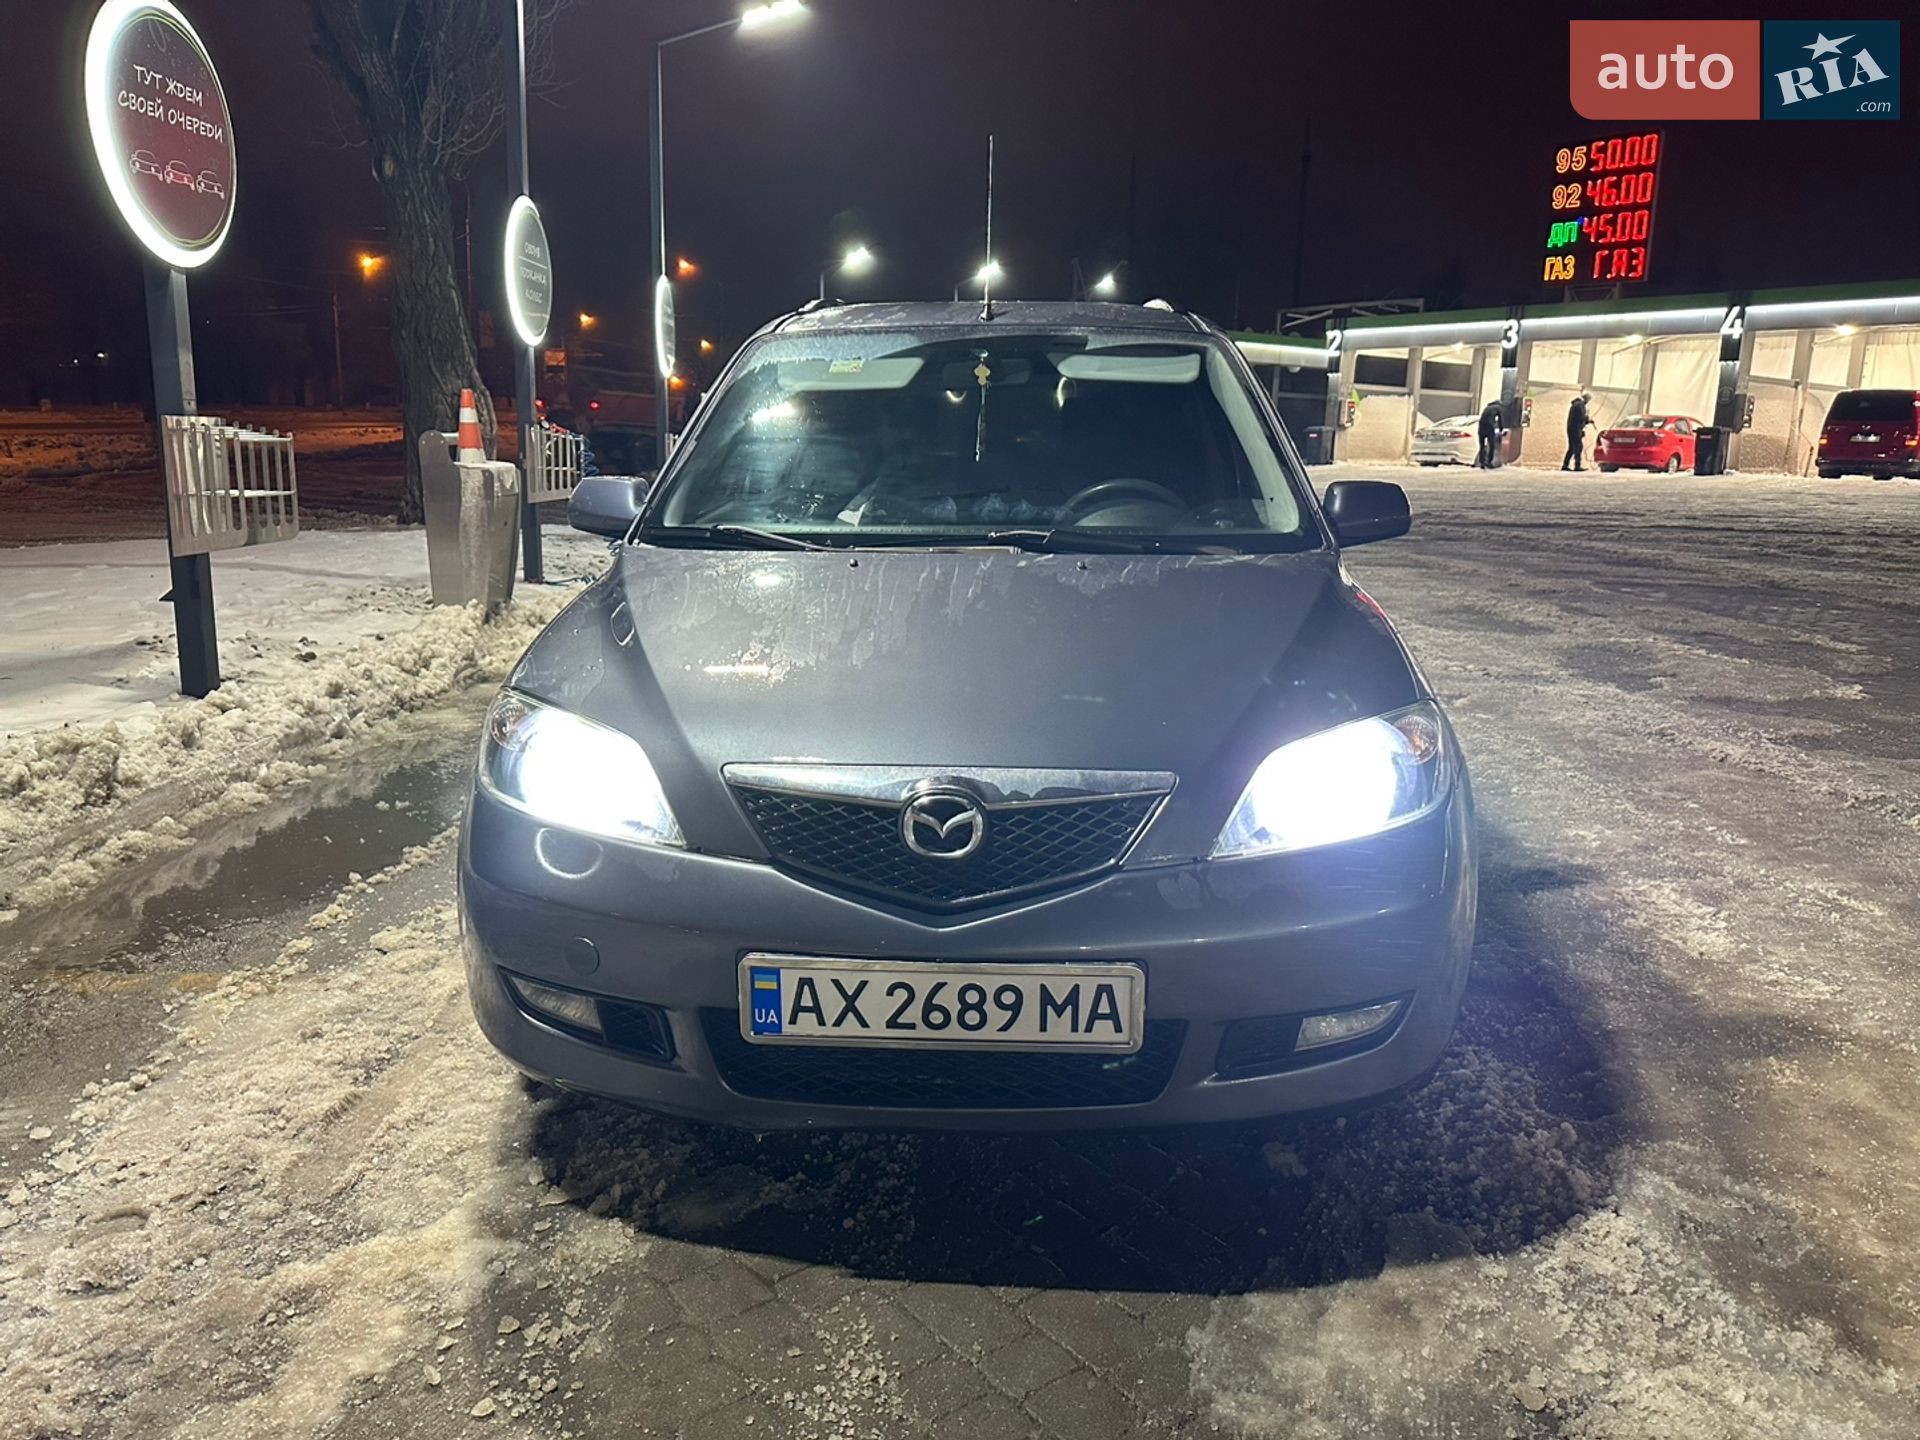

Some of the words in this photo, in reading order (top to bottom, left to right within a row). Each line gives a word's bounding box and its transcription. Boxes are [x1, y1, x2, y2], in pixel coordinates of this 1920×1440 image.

[133, 64, 163, 90] ТУТ
[165, 77, 203, 107] ЖДЕМ
[118, 90, 164, 122] СВОЕЙ
[167, 109, 223, 144] ОЧЕРЕДИ
[1556, 146, 1587, 173] 95
[1590, 133, 1659, 172] 50.00
[1552, 183, 1582, 209] 92
[1586, 172, 1654, 206] 46.00
[1582, 209, 1649, 243] 45.00
[1543, 254, 1576, 281] ГАЗ
[1501, 318, 1519, 349] 3
[1720, 305, 1743, 339] 4
[1326, 329, 1343, 357] 2
[754, 1008, 779, 1025] UA
[788, 977, 870, 1028] AX
[885, 981, 1024, 1032] 2689
[1039, 983, 1123, 1034] MA
